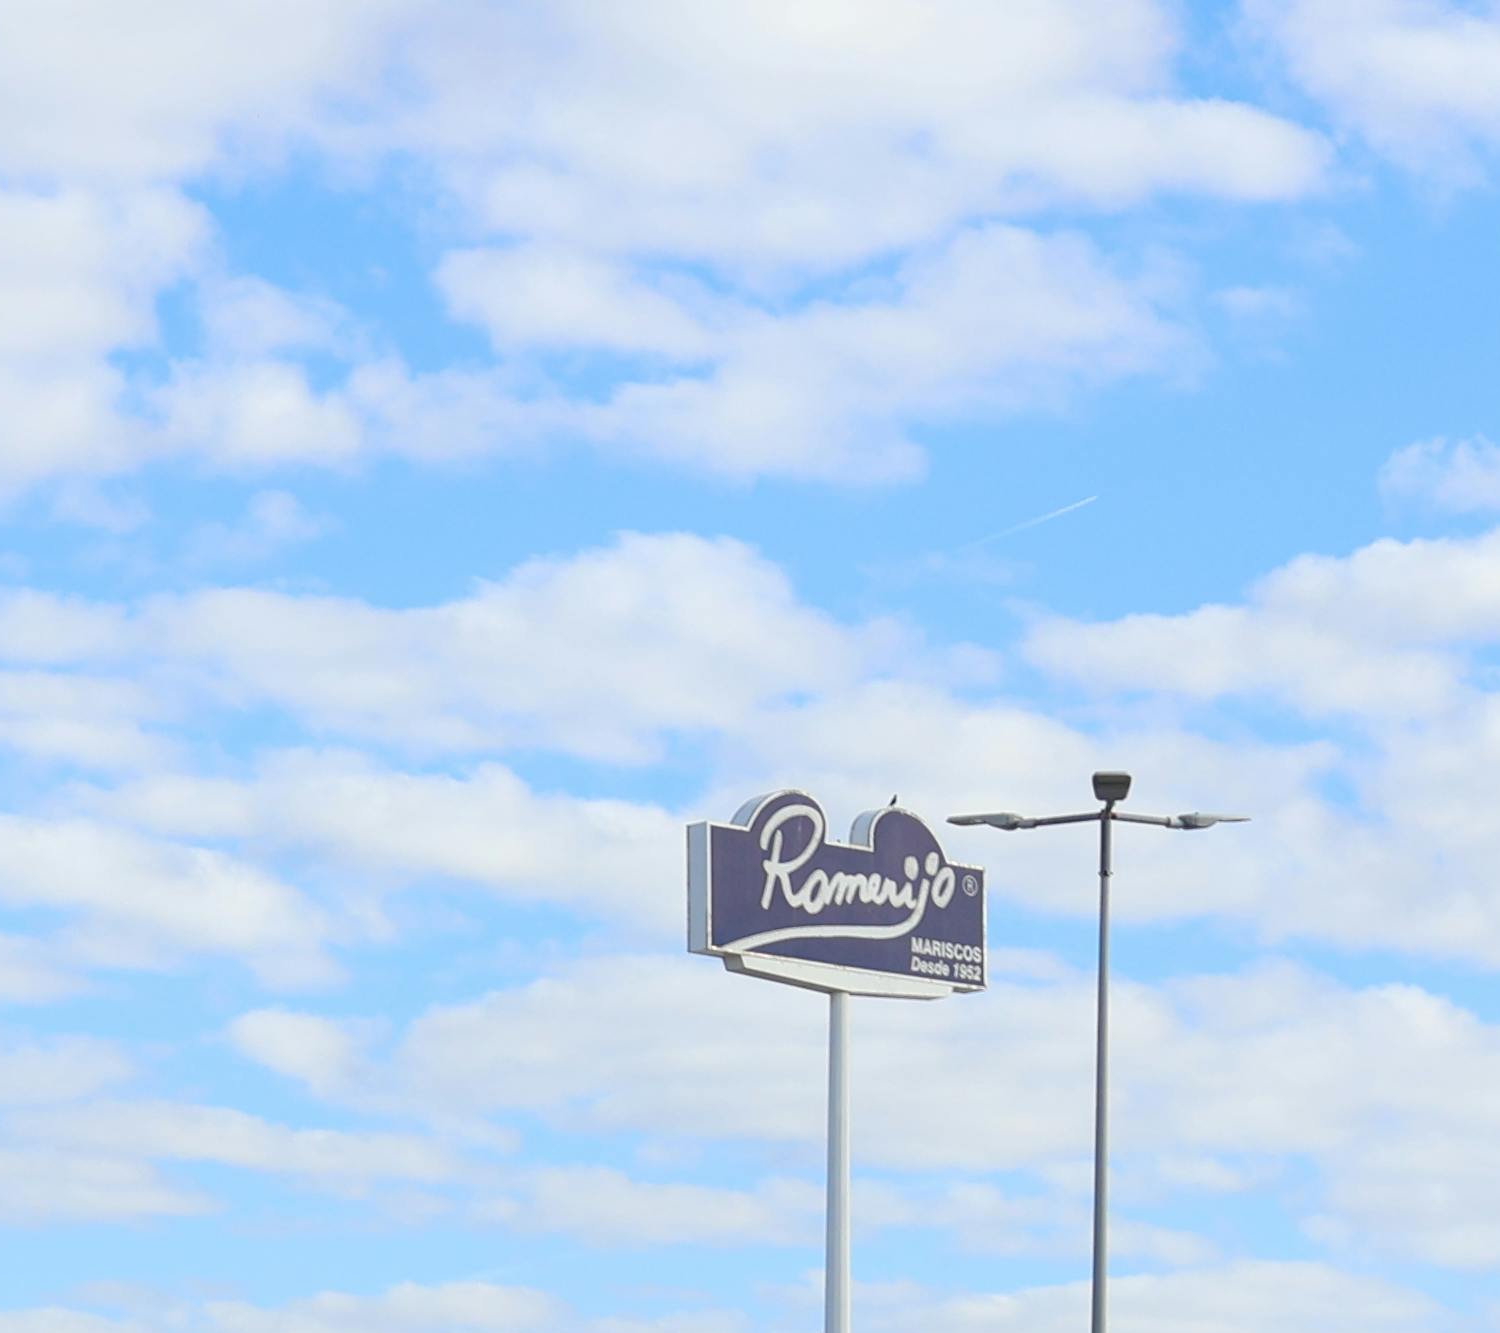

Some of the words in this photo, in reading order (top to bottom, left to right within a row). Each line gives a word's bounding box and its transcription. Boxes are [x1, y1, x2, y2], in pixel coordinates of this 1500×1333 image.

[720, 804, 956, 951] Romerijo
[911, 937, 982, 963] MARISCOS
[911, 956, 950, 976] Desde
[953, 963, 981, 980] 1952
